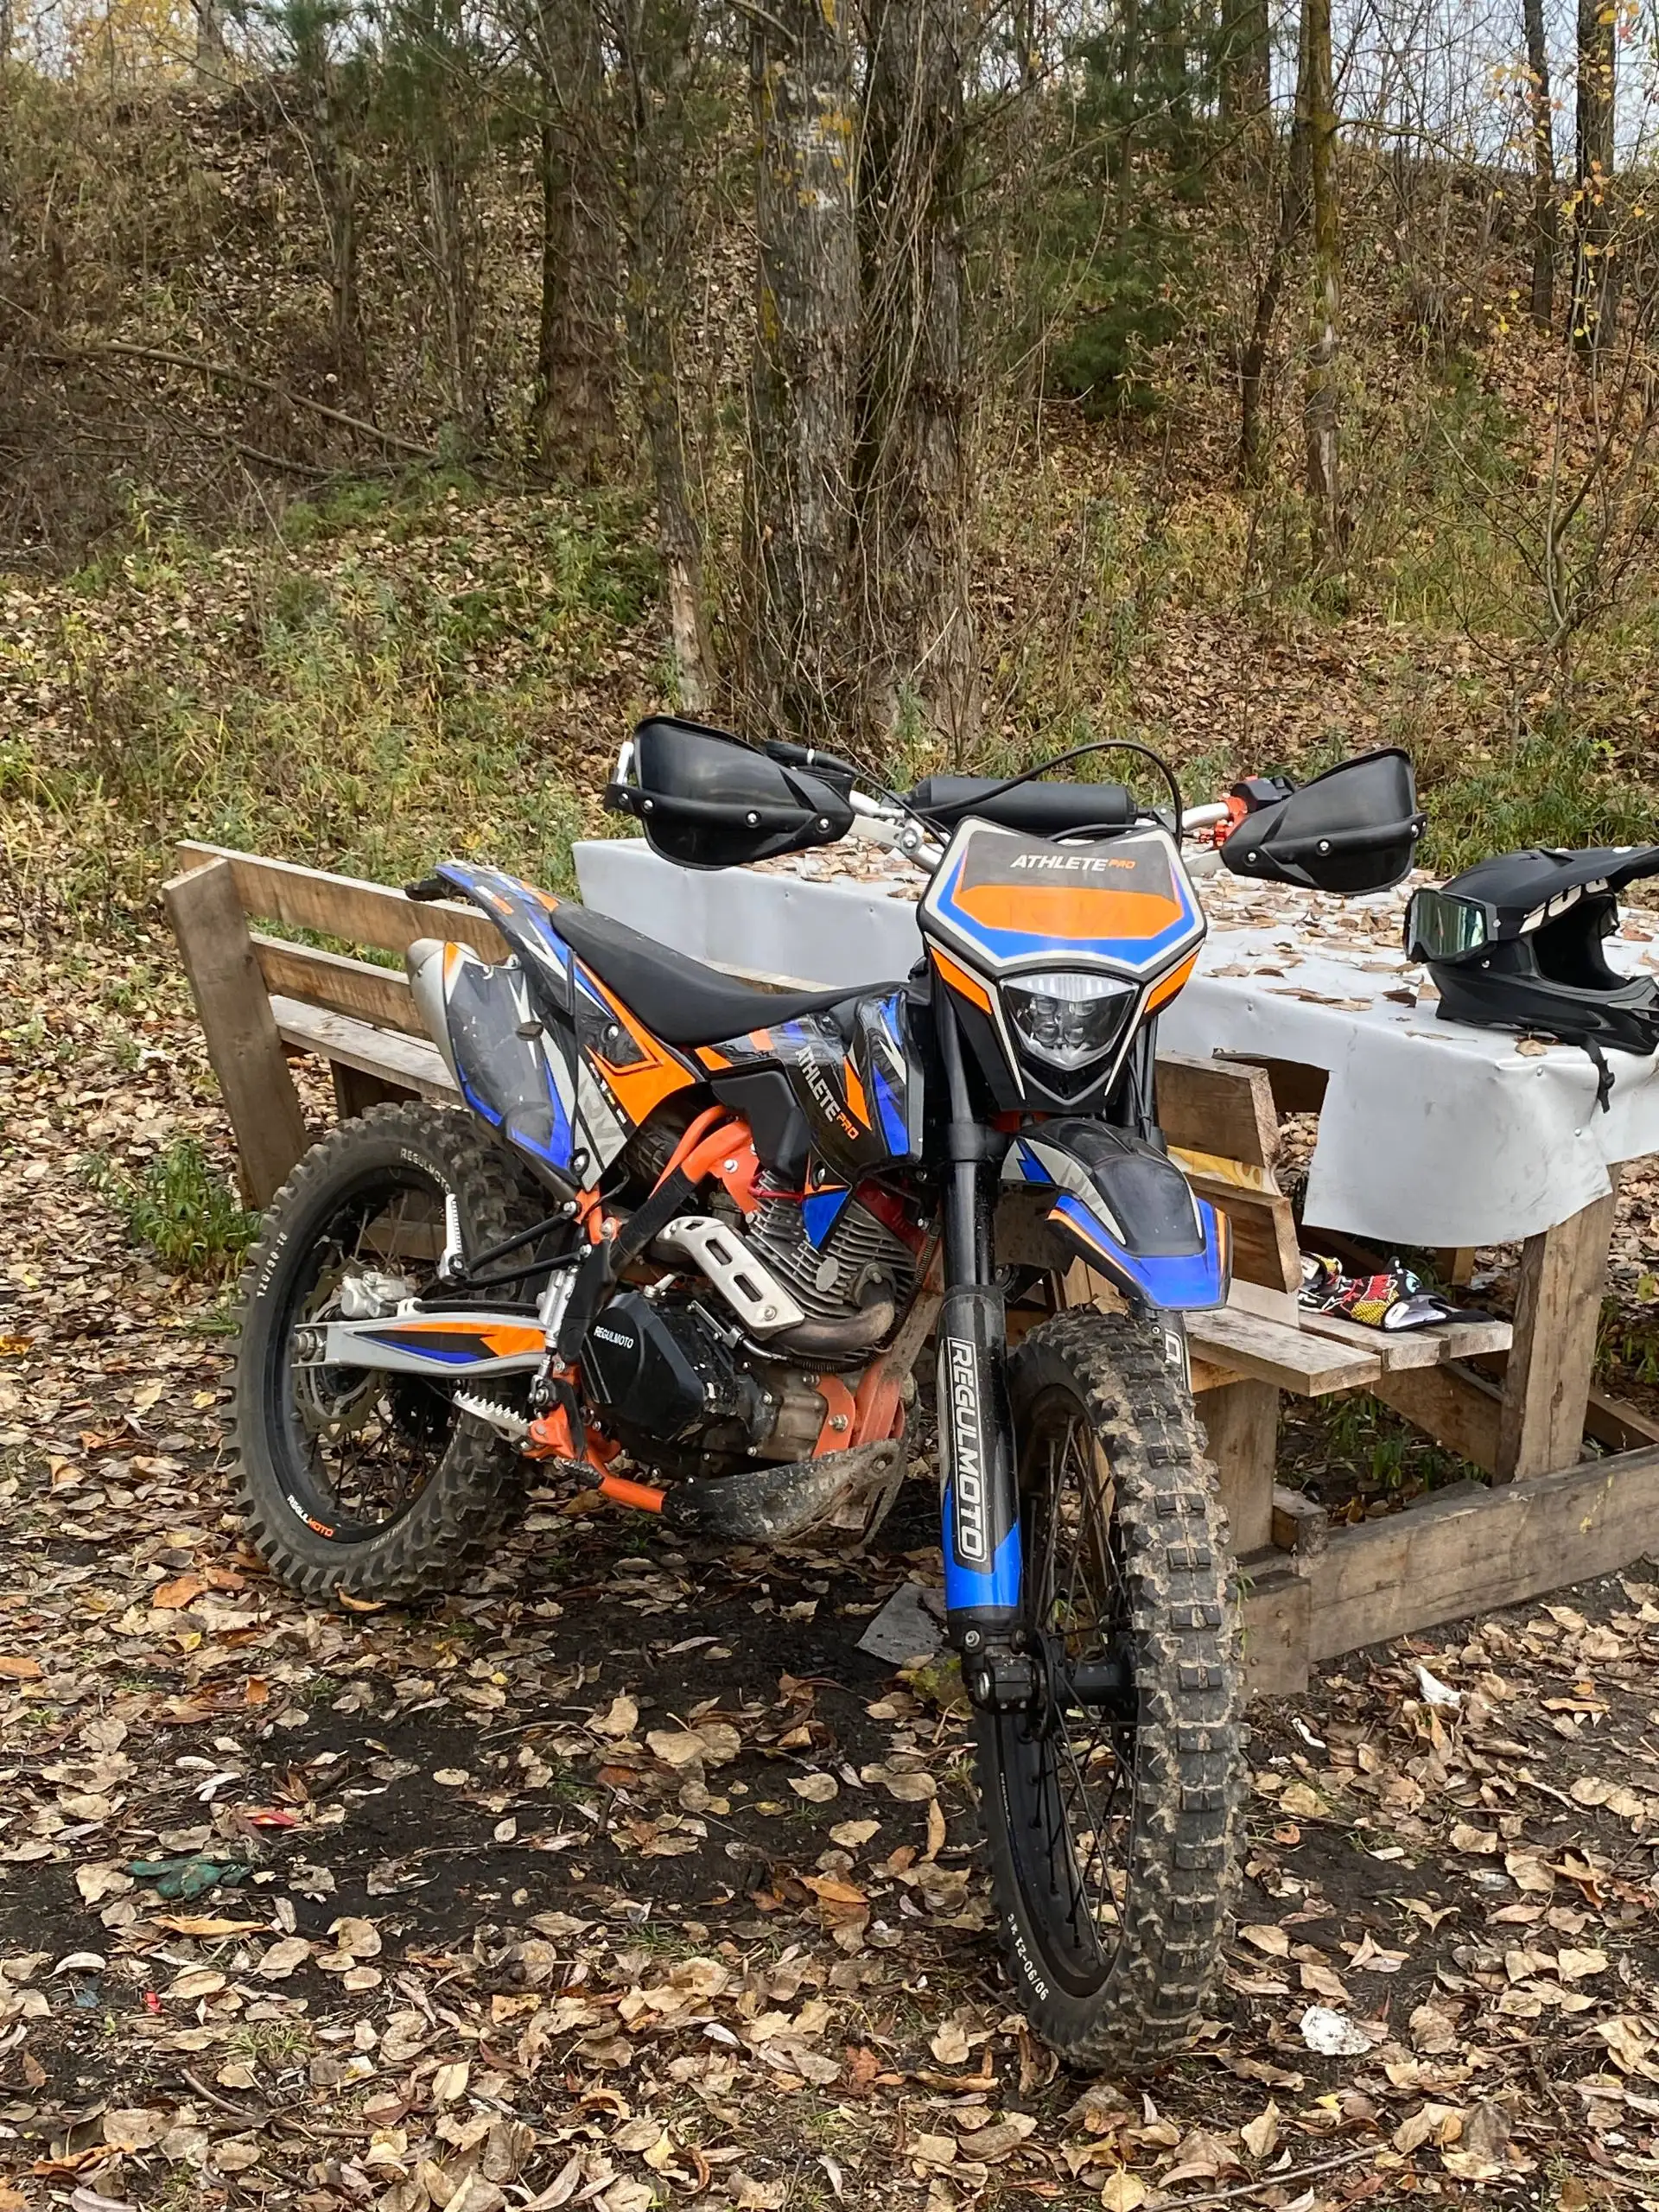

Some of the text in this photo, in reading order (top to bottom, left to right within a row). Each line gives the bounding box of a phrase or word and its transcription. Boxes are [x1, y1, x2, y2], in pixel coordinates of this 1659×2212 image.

[1010, 855, 1135, 871] ATHLETE PRO
[795, 1046, 859, 1140] ATHLETE PRO
[594, 1325, 634, 1349] REGULMOTO
[951, 1340, 982, 1558] REGULMOTO
[1014, 1936, 1049, 2000] 90/90-21
